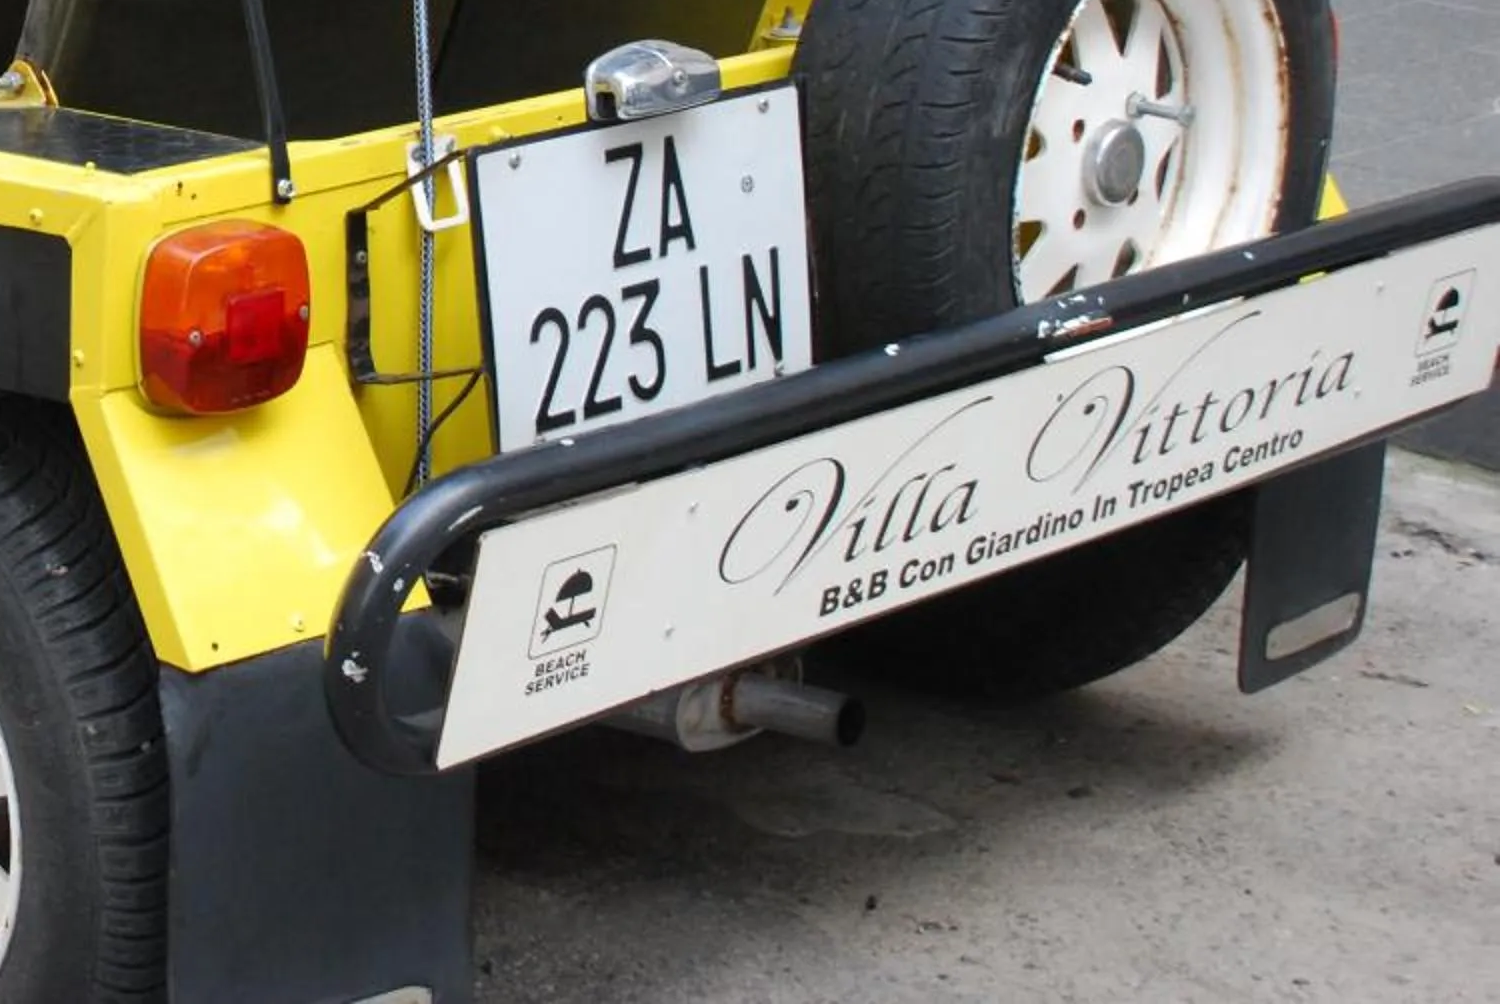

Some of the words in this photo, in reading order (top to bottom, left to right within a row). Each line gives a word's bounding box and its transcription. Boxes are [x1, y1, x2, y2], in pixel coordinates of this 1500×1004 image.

[605, 135, 696, 269] ZA
[529, 278, 667, 433] 223
[699, 246, 783, 383] LN
[718, 395, 994, 598] Villa
[1026, 310, 1363, 496] Vittoria
[818, 566, 889, 619] B&B
[898, 547, 956, 590] Con
[965, 506, 1084, 567] Giardino
[1091, 493, 1118, 523] In
[1127, 459, 1215, 509] Tropea
[1222, 427, 1305, 474] Centro
[524, 664, 591, 698] SERVICE
[534, 649, 588, 678] BEACH
